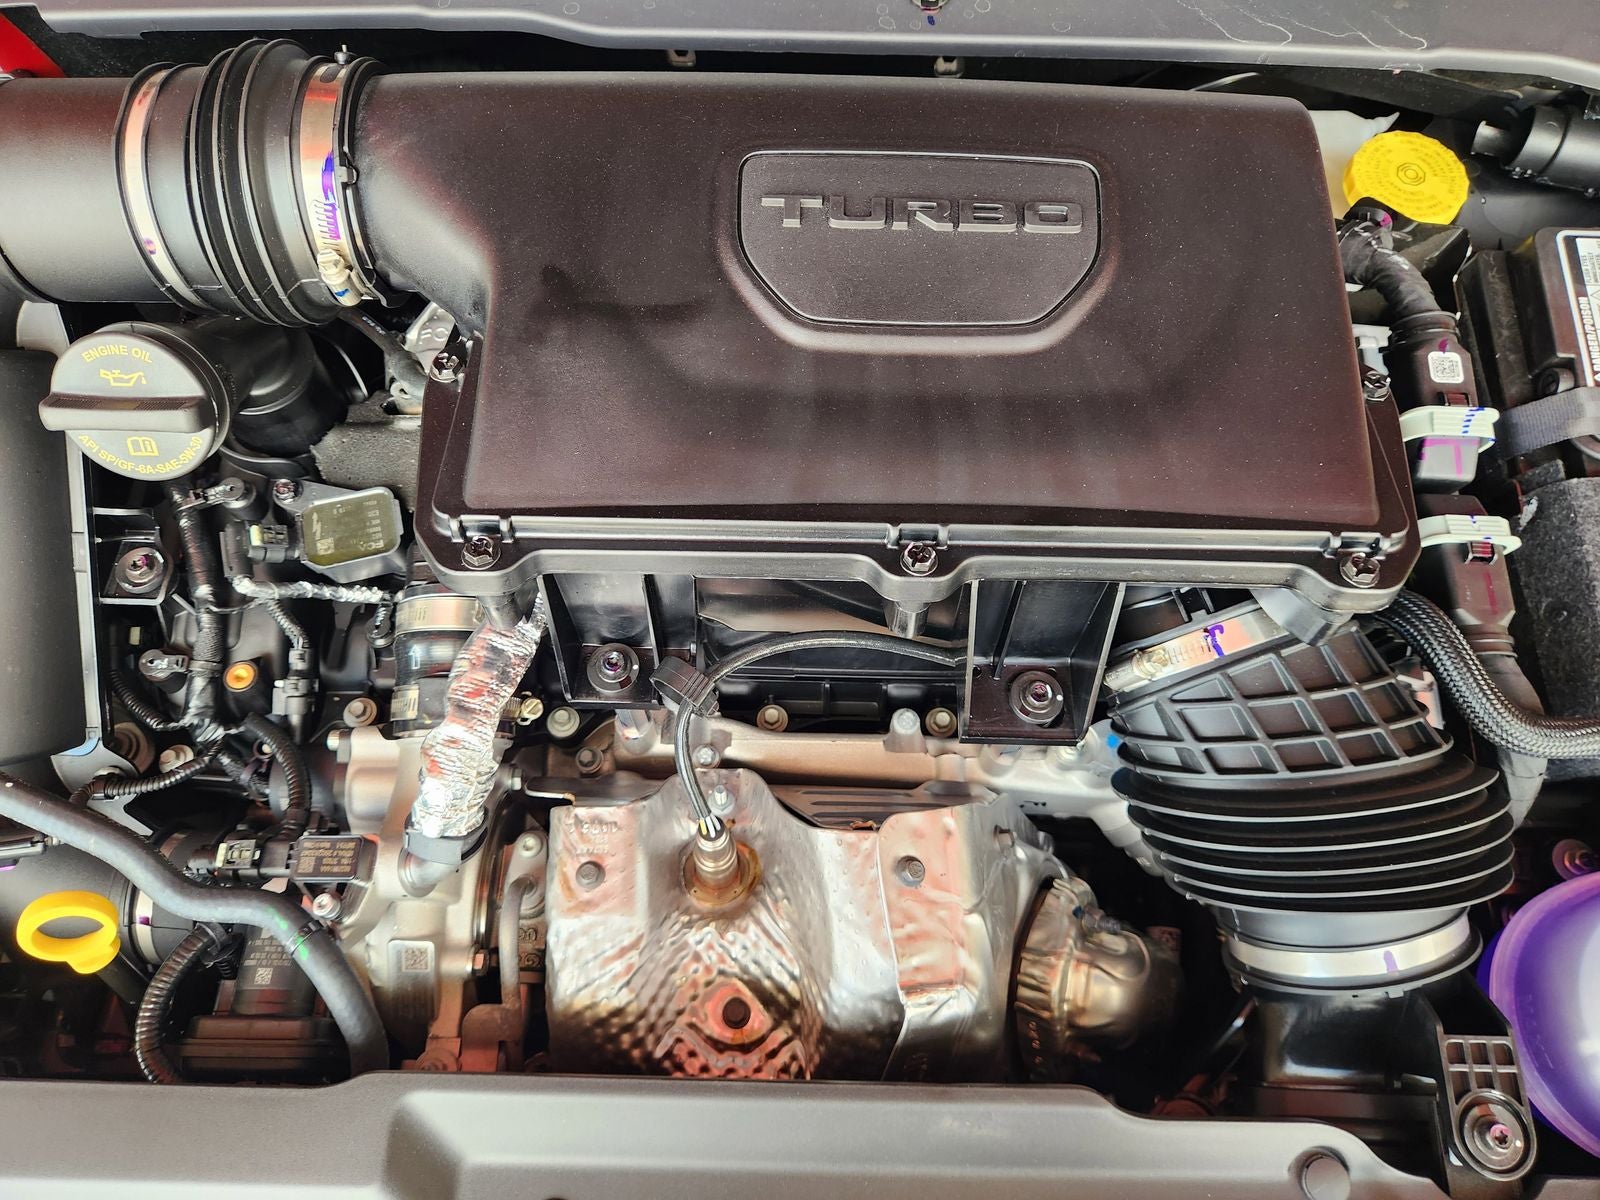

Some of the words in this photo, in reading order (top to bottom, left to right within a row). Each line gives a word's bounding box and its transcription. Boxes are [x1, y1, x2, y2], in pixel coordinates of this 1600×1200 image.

[761, 195, 1082, 233] TURBO
[82, 345, 128, 362] ENGINE
[132, 347, 152, 362] OIL
[79, 435, 100, 452] API
